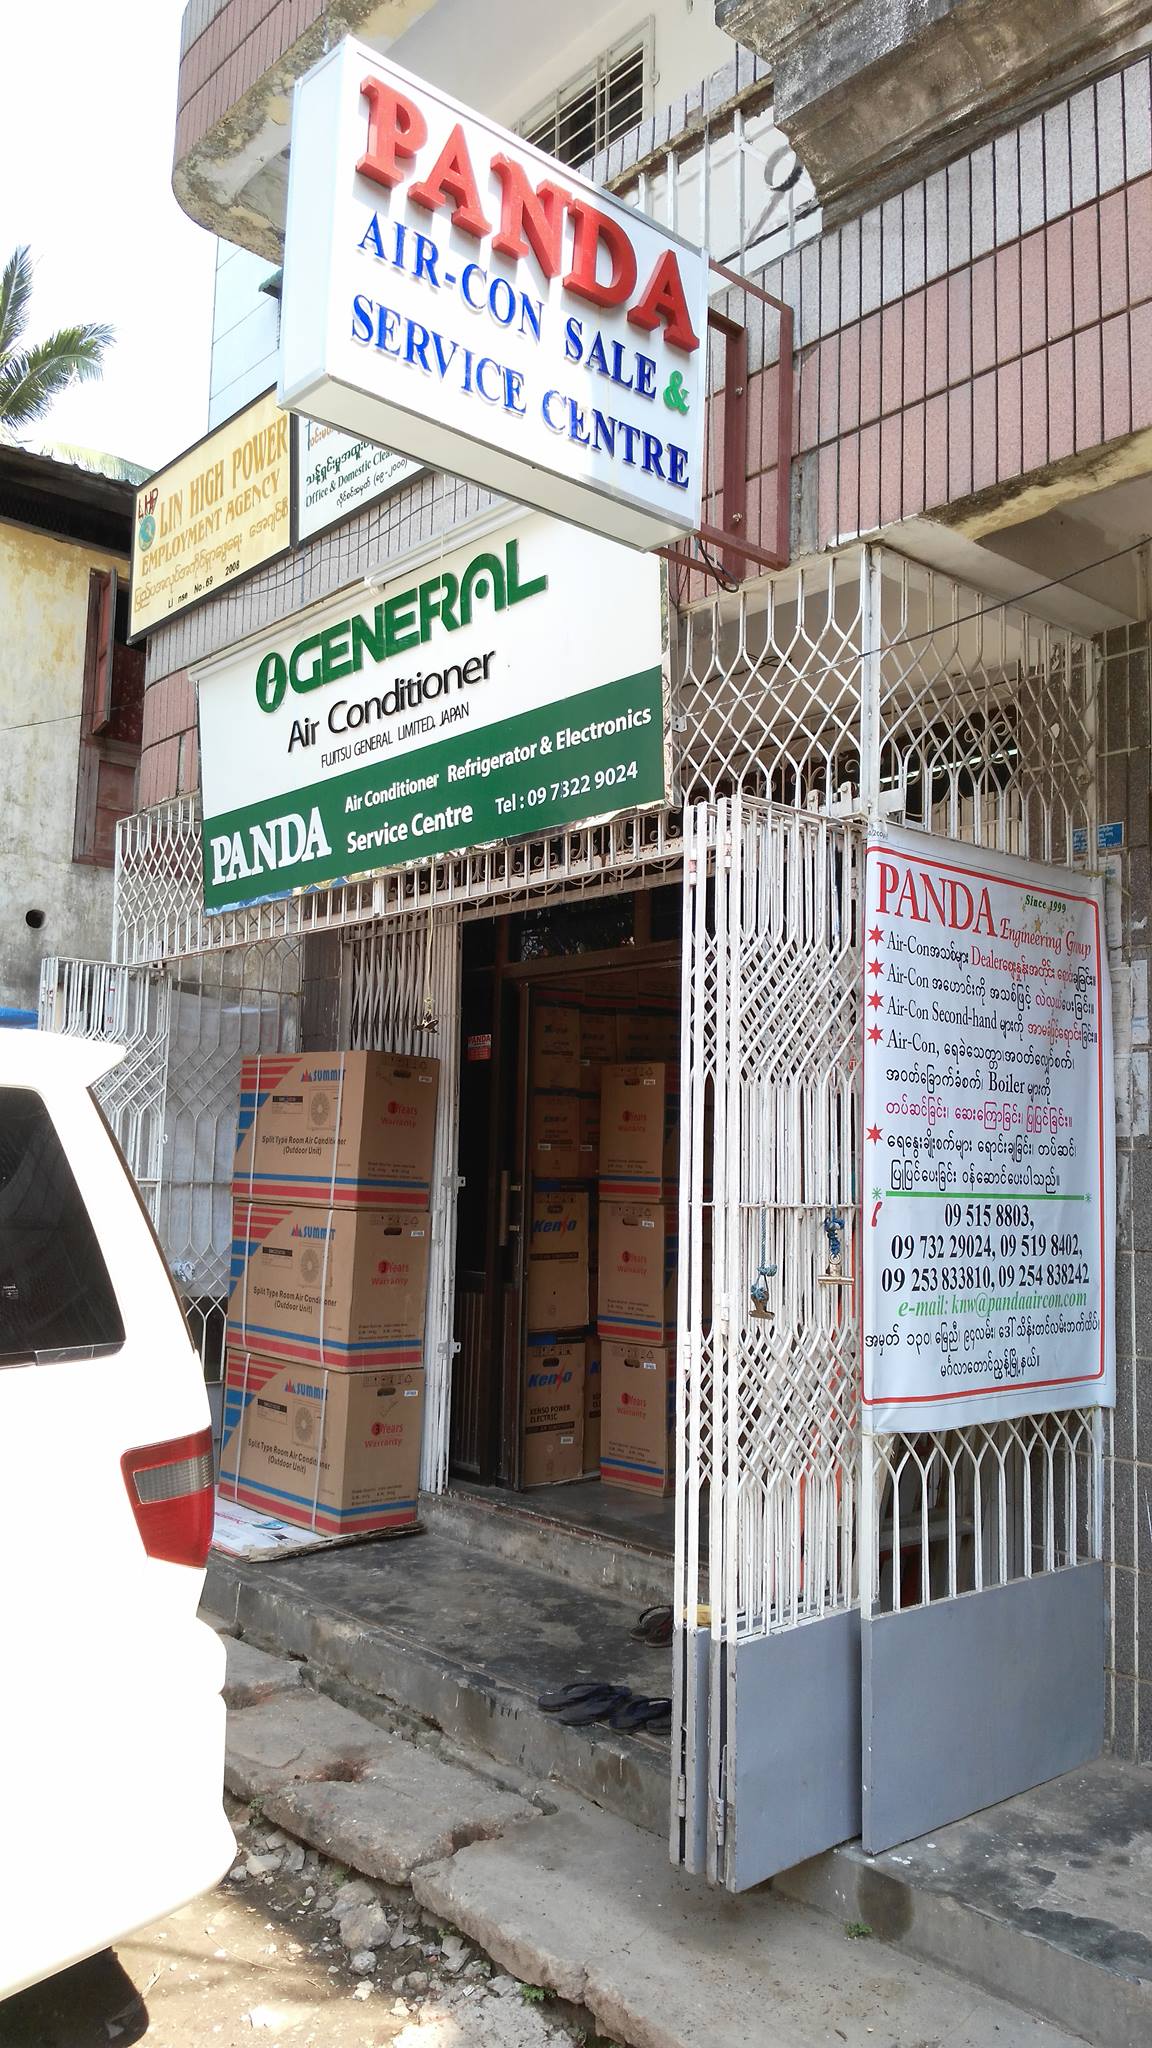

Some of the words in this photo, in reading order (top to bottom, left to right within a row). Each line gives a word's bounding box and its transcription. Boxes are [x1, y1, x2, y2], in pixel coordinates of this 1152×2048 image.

[356, 74, 700, 353] PANDA
[357, 211, 544, 343] AIR-CON
[564, 316, 657, 401] SALE
[663, 370, 689, 414] &
[351, 293, 526, 415] SERVICE
[541, 389, 689, 490] CENTRE
[159, 489, 182, 538] LIN
[189, 457, 224, 519] HIGH
[232, 414, 288, 482] POWER
[305, 488, 329, 508] Office
[329, 480, 336, 493] &
[337, 459, 372, 488] Domestic
[138, 487, 159, 519] LHP
[141, 505, 223, 577] EMPLOYMENT
[225, 467, 280, 527] AGENCY
[289, 538, 549, 695] GENERAL
[287, 717, 320, 753] Air
[327, 649, 496, 735] Conditioner
[321, 743, 352, 769] FUJITSU
[353, 731, 393, 756] GENERAL
[439, 701, 469, 727] JAPAN
[344, 795, 362, 814] Air
[363, 773, 439, 808] Conditioner
[447, 742, 538, 784] Refrigerator
[540, 736, 553, 753] &
[555, 706, 652, 751] Electronics
[527, 787, 547, 808] 09
[550, 777, 591, 803] 7322
[593, 760, 638, 793] 9024
[210, 806, 332, 886] PANDA
[347, 820, 408, 855] Service
[410, 803, 474, 841] Centre
[875, 861, 998, 938] PANDA
[1024, 894, 1047, 909] Since
[1049, 897, 1067, 914] 1999
[1000, 917, 1062, 955] Engineering
[887, 963, 929, 988] Air-Con
[887, 996, 929, 1021] Air-Con
[932, 1001, 997, 1030] Second-hand
[886, 1029, 940, 1058] Air-Con,
[988, 1071, 1025, 1094] Boiler
[289, 1136, 304, 1144] Room
[945, 1203, 961, 1227] 09
[966, 1204, 991, 1227] 515
[996, 1204, 1034, 1231] 8803,
[891, 1234, 915, 1259] 09
[920, 1235, 944, 1259] 732
[949, 1234, 996, 1261] 29024,
[1000, 1234, 1017, 1257] 09
[1021, 1234, 1046, 1257] 519
[1050, 1234, 1083, 1259] 8402,
[266, 1288, 278, 1298] Type
[279, 1290, 295, 1300] Room
[295, 1292, 304, 1301] Air
[882, 1267, 905, 1292] 09
[911, 1267, 938, 1292] 253
[941, 1265, 995, 1293] 833810,
[998, 1265, 1015, 1287] 09
[1019, 1264, 1043, 1287] 254
[1046, 1263, 1090, 1285] 838242
[898, 1295, 949, 1317] e-mail:
[951, 1290, 1087, 1318] knw@pandaaircon.com
[865, 1323, 900, 1356] အမှတ်
[248, 1438, 261, 1448] Split
[261, 1442, 273, 1453] Type
[273, 1446, 289, 1457] Room
[289, 1450, 298, 1460] Air
